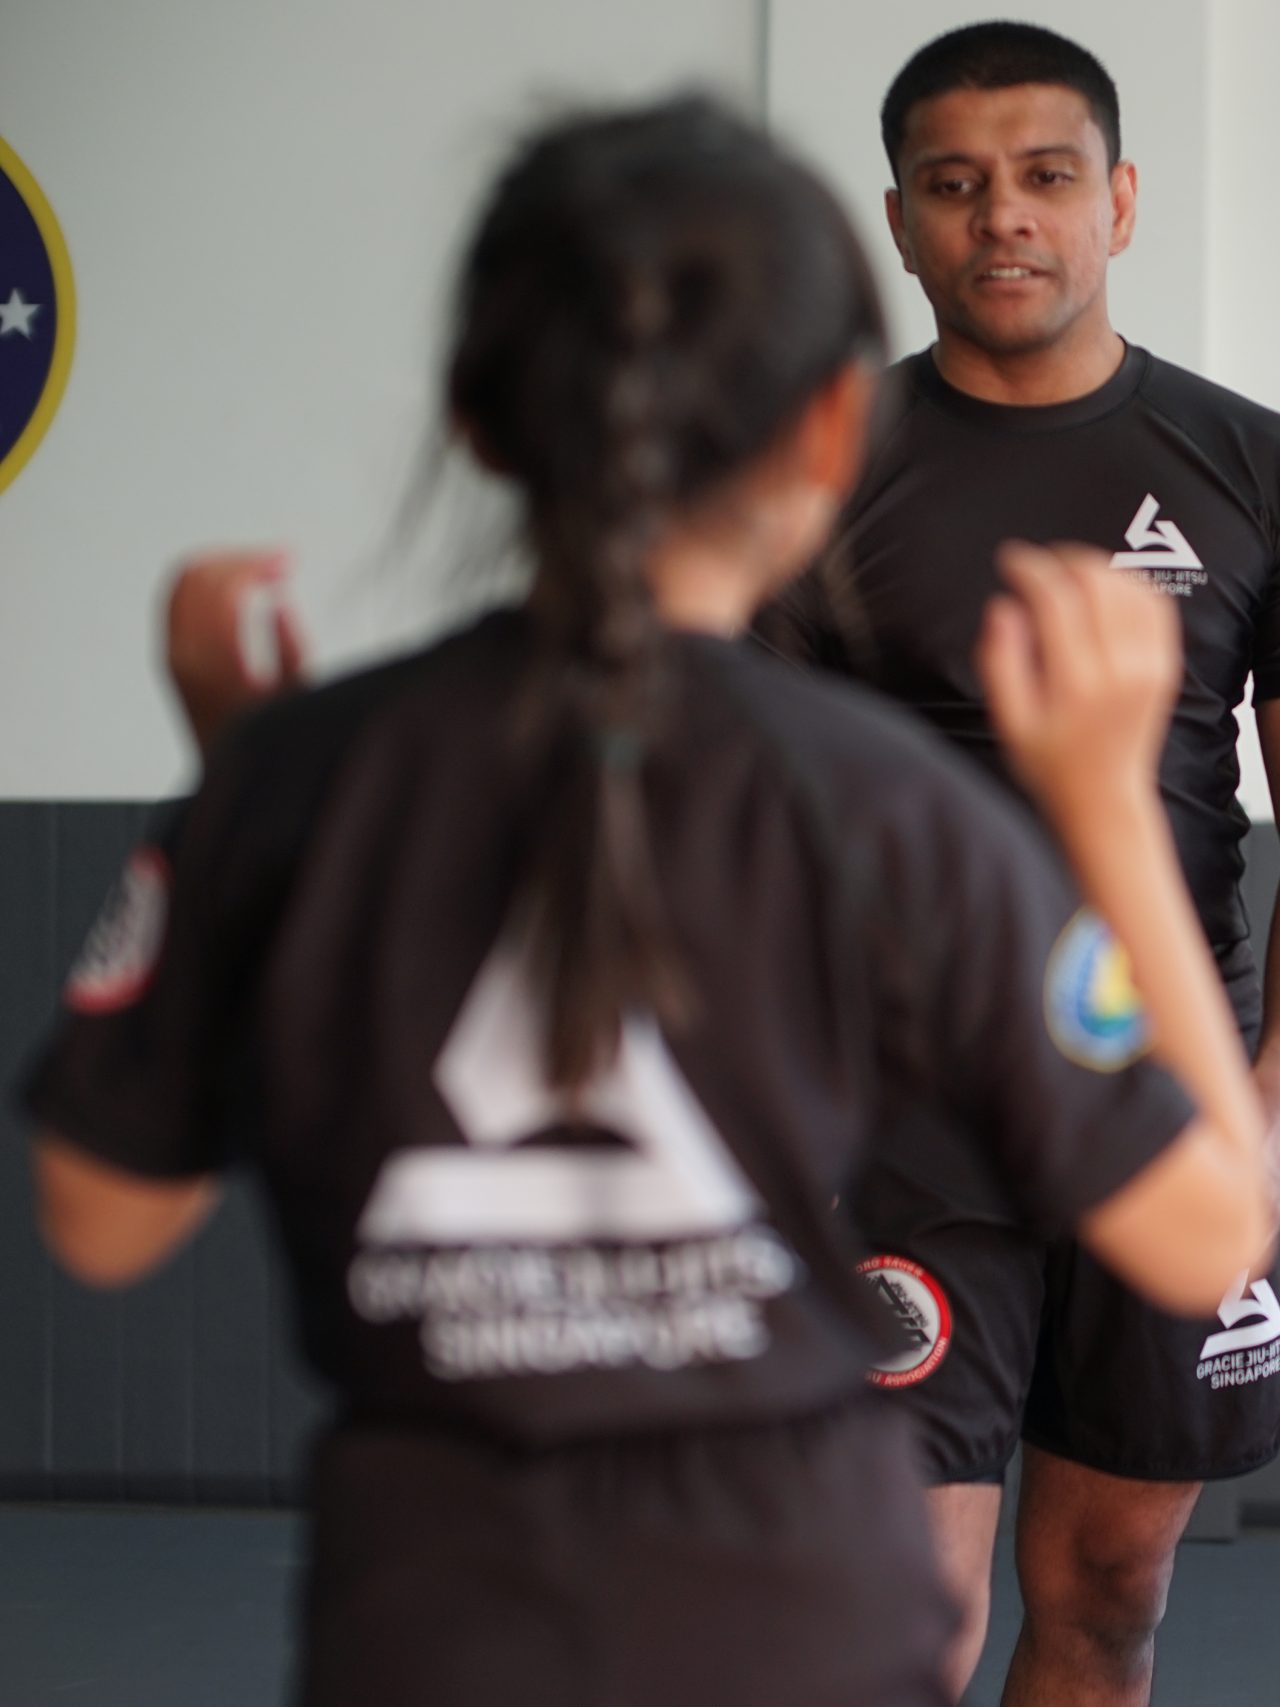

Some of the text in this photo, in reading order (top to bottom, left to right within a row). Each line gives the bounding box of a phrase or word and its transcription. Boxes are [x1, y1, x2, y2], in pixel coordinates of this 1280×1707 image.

[1153, 569, 1208, 586] JIU-JITSU
[1151, 581, 1194, 597] APORE
[1196, 1350, 1245, 1380] GRACIE
